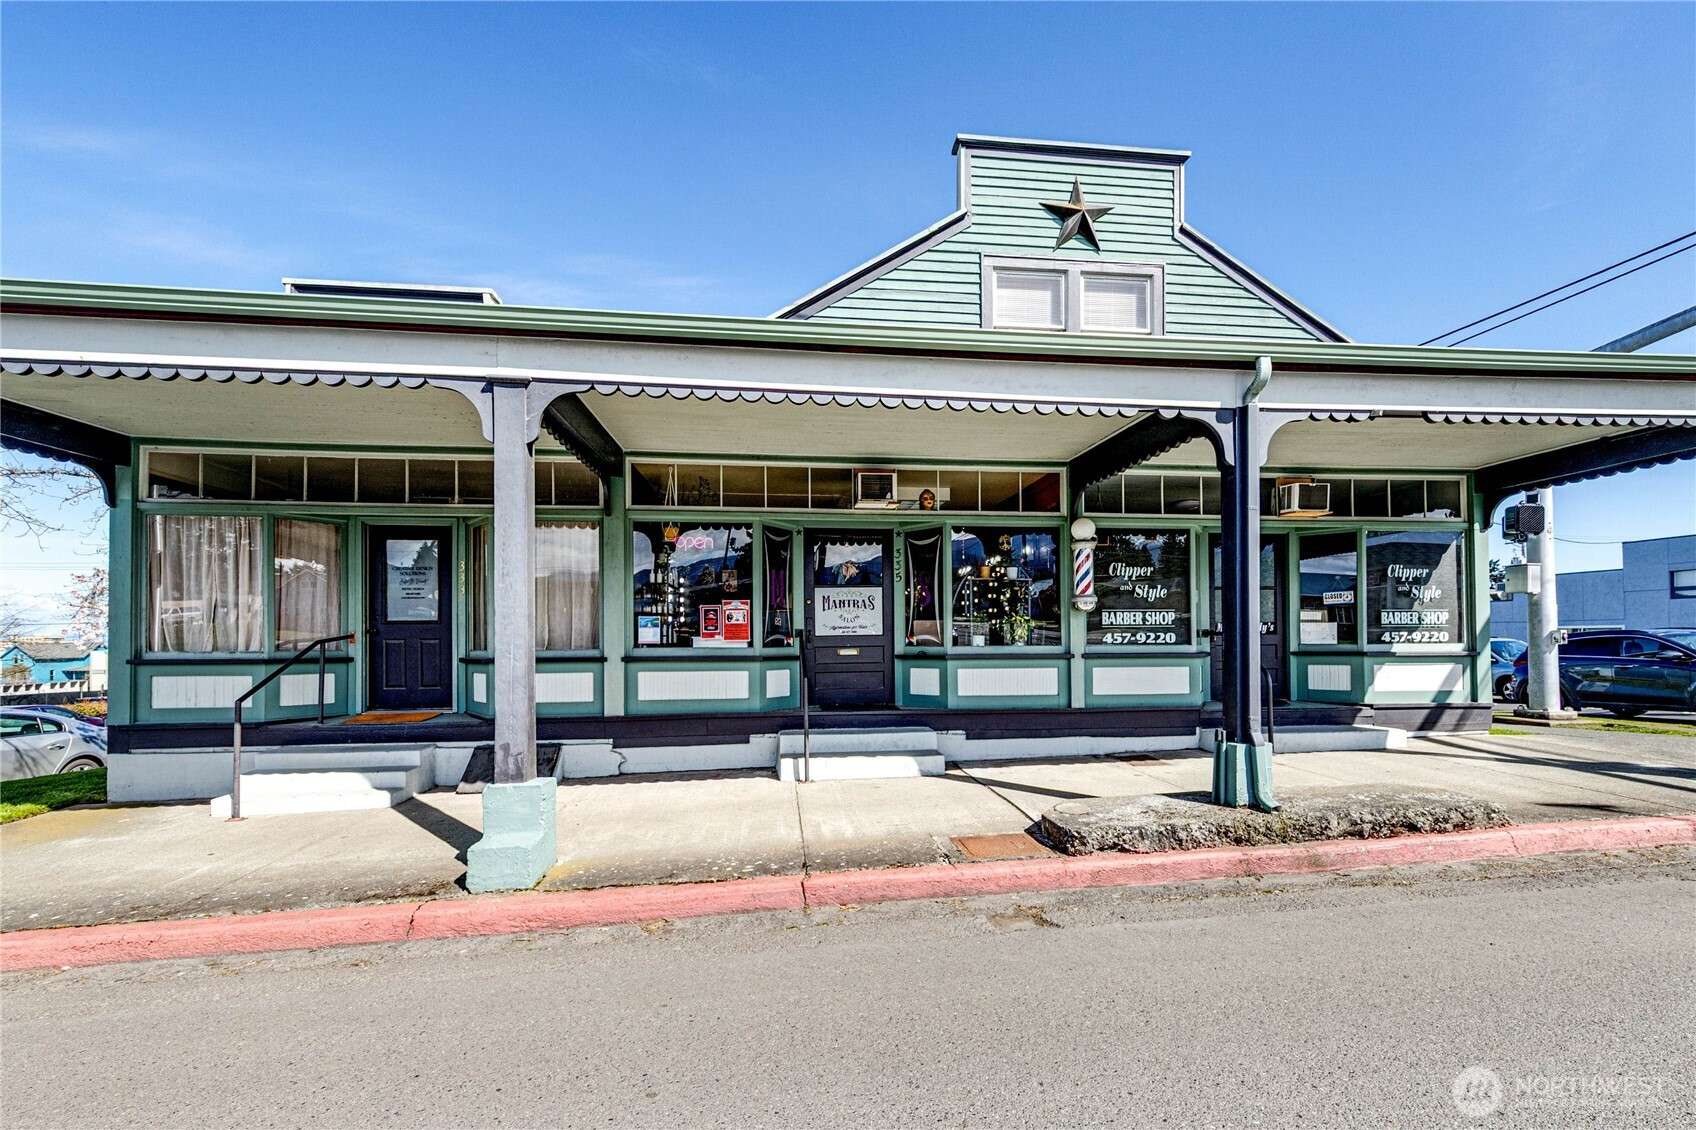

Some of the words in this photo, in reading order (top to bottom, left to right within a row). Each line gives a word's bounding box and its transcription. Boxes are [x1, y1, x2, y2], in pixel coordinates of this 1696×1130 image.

[674, 536, 713, 550] open
[894, 548, 903, 582] 335
[1109, 562, 1154, 580] Clipper
[1387, 564, 1428, 582] Clipper
[1120, 581, 1133, 591] and
[1133, 584, 1168, 602] Style
[1324, 592, 1342, 600] CLOSED
[1398, 583, 1410, 592] and
[1410, 585, 1442, 603] Style
[822, 594, 876, 612] MANTRAS
[837, 613, 860, 623] SALON
[1102, 611, 1143, 625] BARBER
[1145, 611, 1176, 625] SHOP
[1381, 611, 1419, 625] BARBER
[1421, 611, 1449, 625] SHOP
[1102, 632, 1176, 643] 457-9220
[1381, 631, 1449, 642] 457-9220
